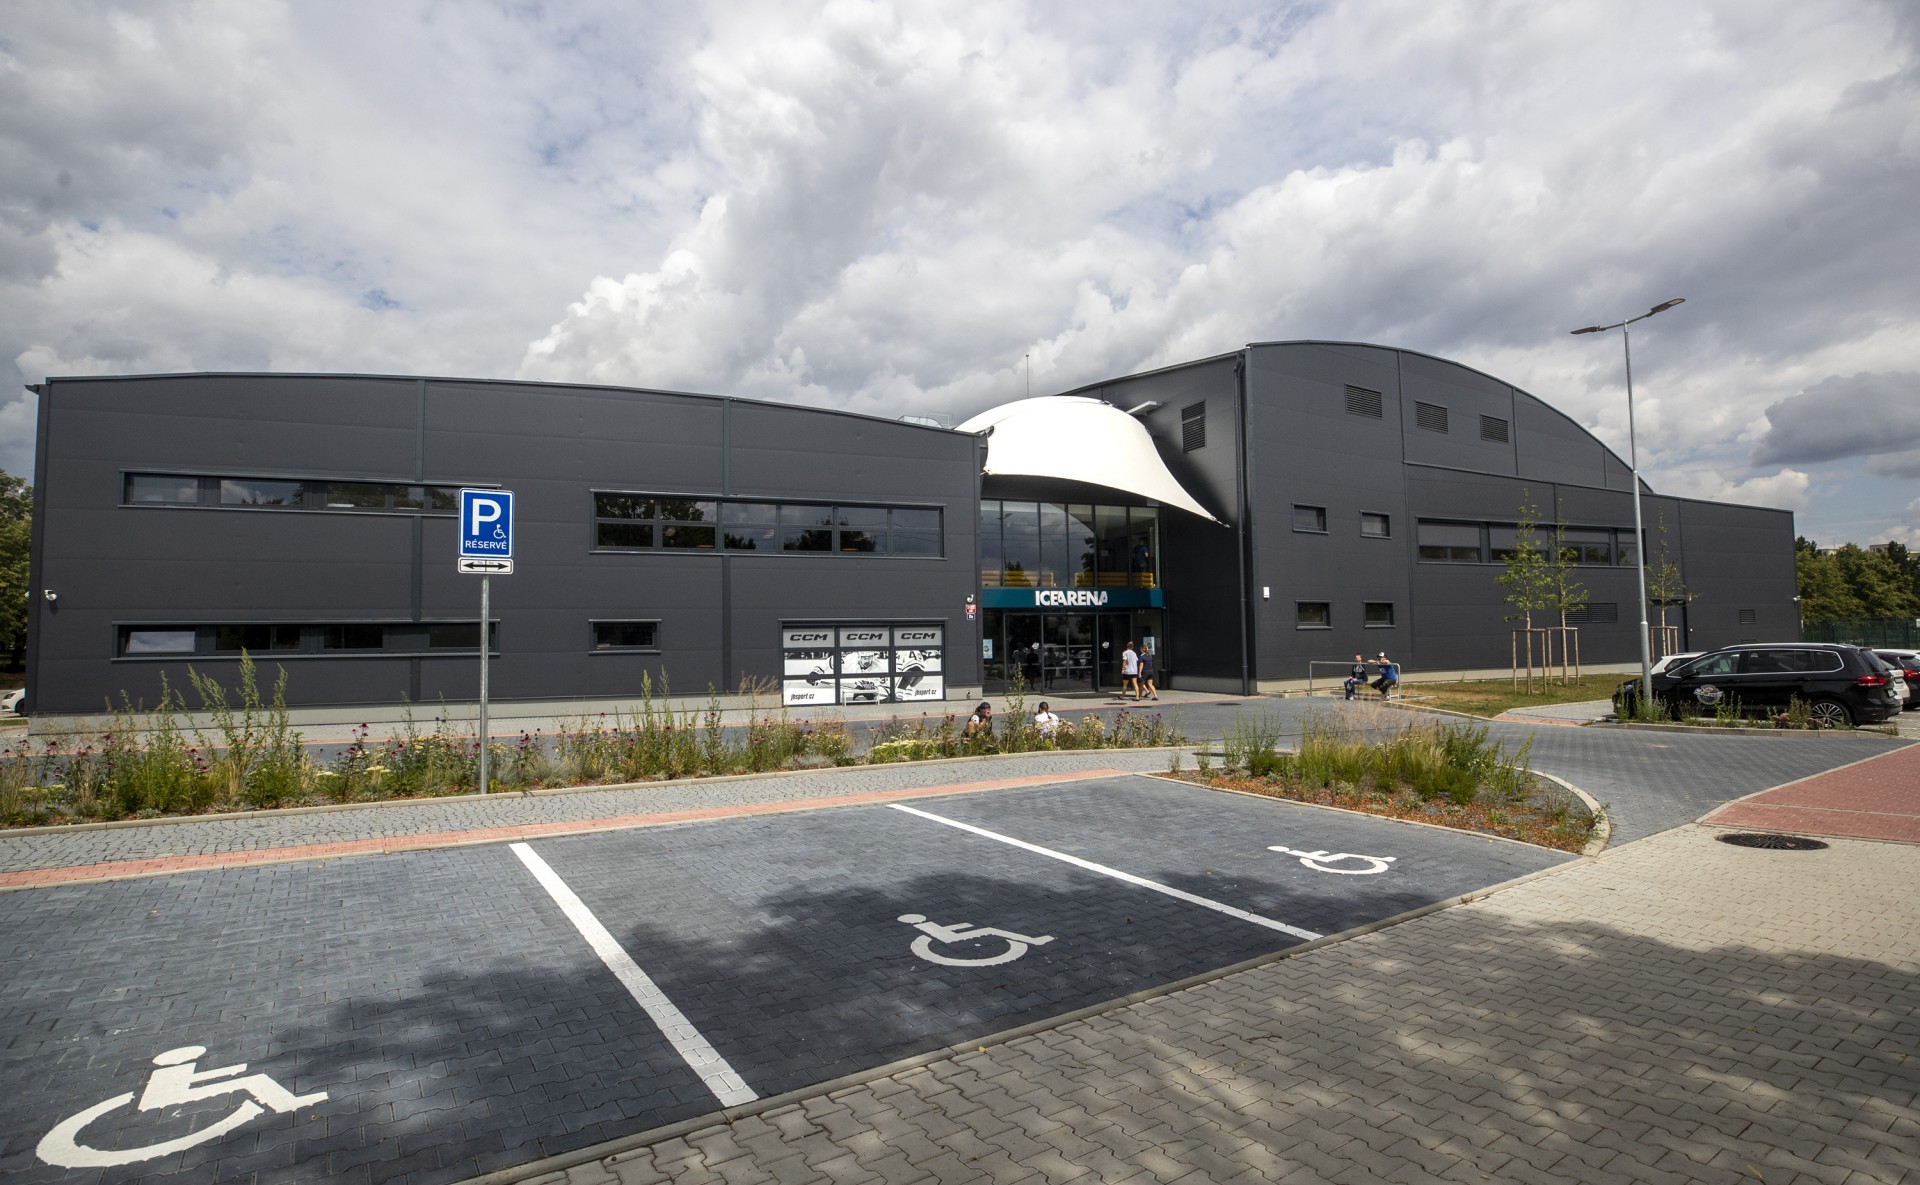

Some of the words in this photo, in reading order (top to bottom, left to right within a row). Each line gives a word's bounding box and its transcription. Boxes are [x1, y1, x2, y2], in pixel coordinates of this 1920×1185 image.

[472, 498, 502, 536] P
[465, 539, 507, 550] RÉSERVÉ
[1035, 590, 1108, 606] ICEARENA
[900, 632, 936, 640] CCM
